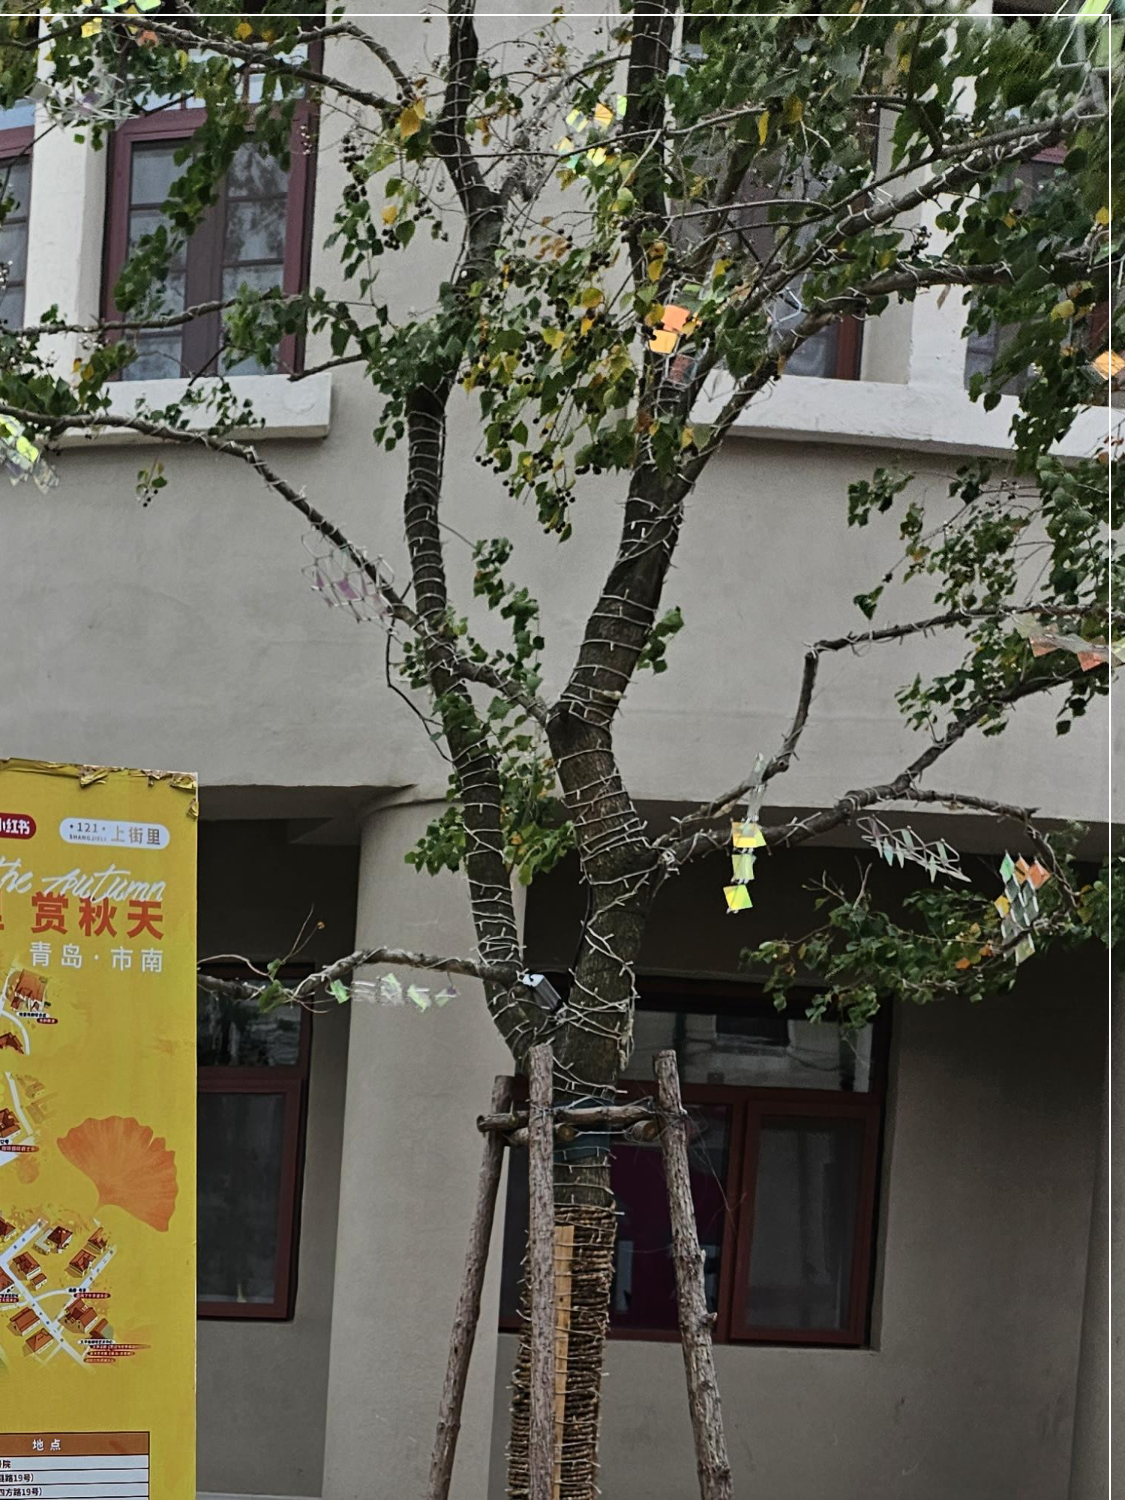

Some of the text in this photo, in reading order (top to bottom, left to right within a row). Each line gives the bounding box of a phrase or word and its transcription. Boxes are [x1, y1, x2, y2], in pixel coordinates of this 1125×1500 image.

[111, 826, 161, 845] 上街里
[31, 891, 164, 939] 赏秋天
